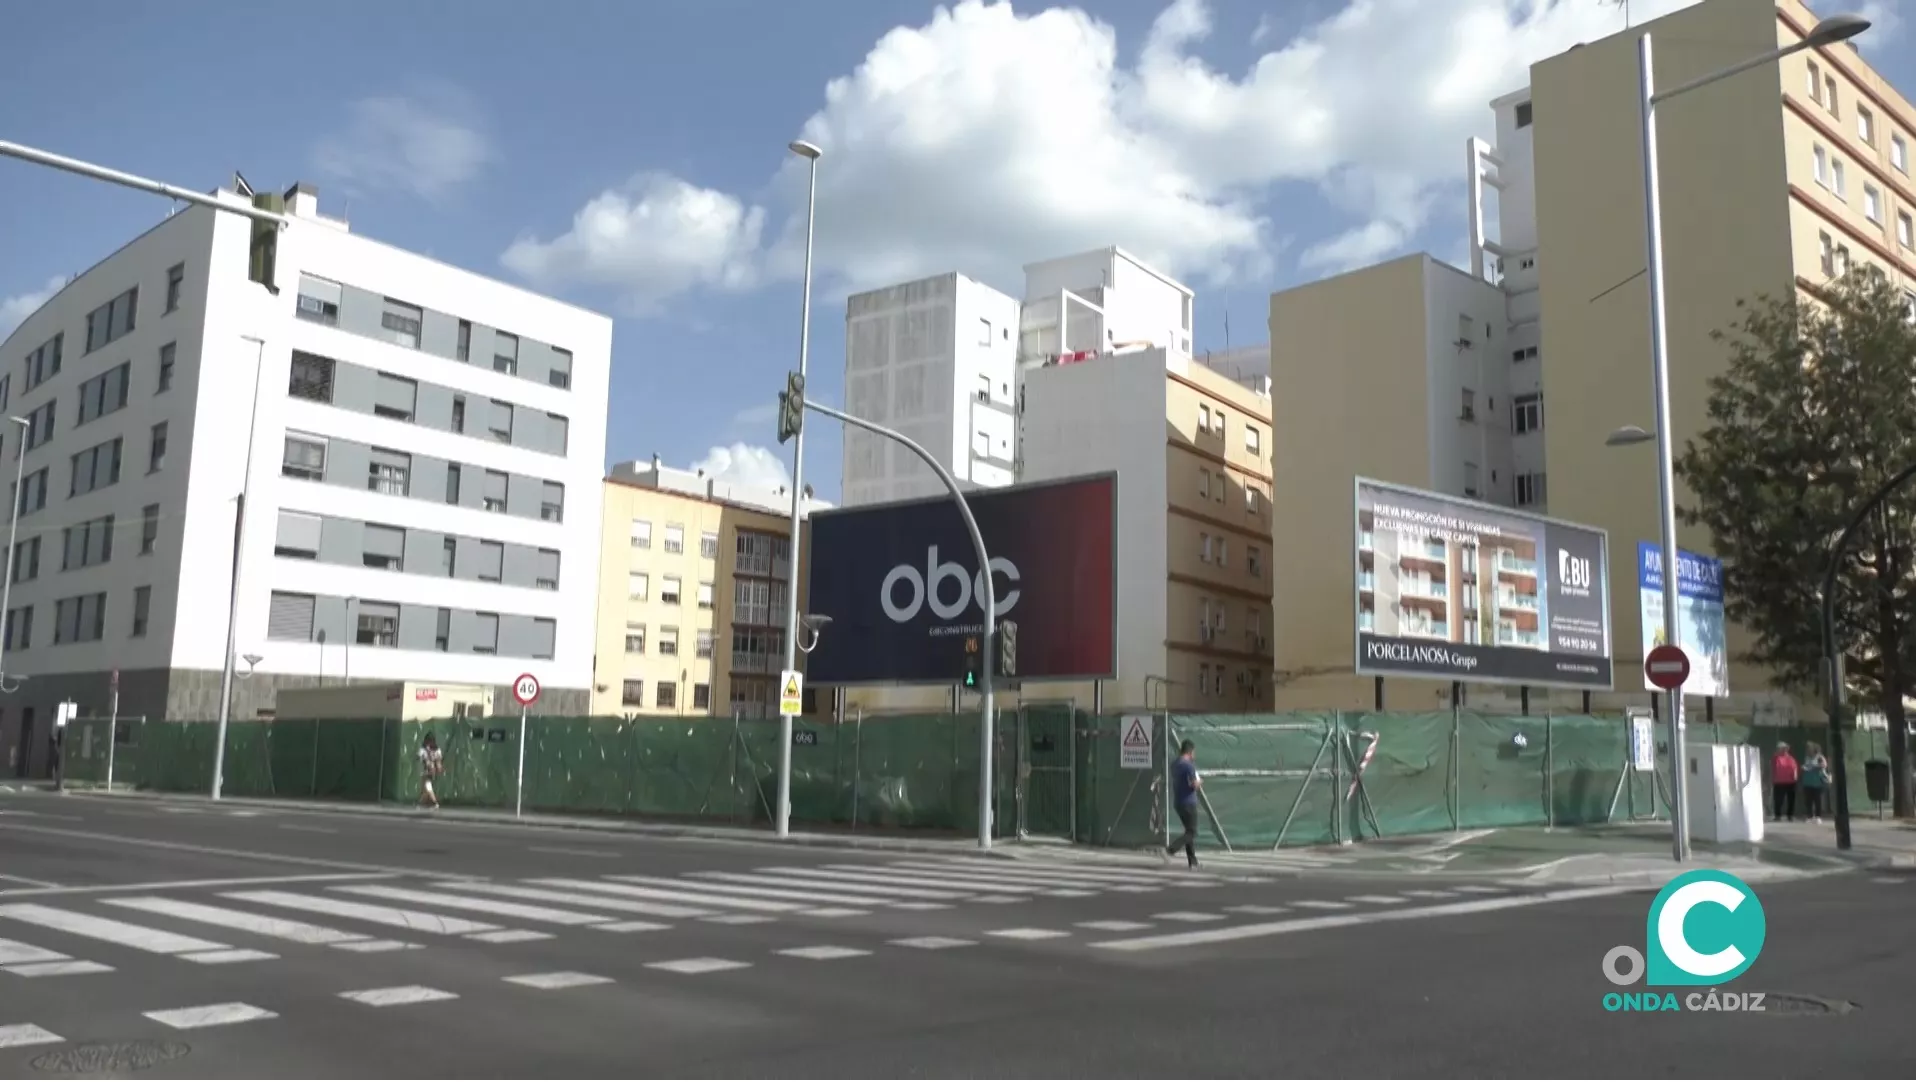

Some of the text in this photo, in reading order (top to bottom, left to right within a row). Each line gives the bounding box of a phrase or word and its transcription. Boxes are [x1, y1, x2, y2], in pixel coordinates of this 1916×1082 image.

[1373, 502, 1400, 518] NUEVA
[1447, 517, 1458, 529] DE
[1373, 517, 1419, 535] EXCLUSIVAS
[1419, 525, 1430, 538] EN
[880, 544, 1021, 624] obc
[1367, 640, 1478, 671] PORCELANOSA Grupo
[519, 682, 535, 695] 40
